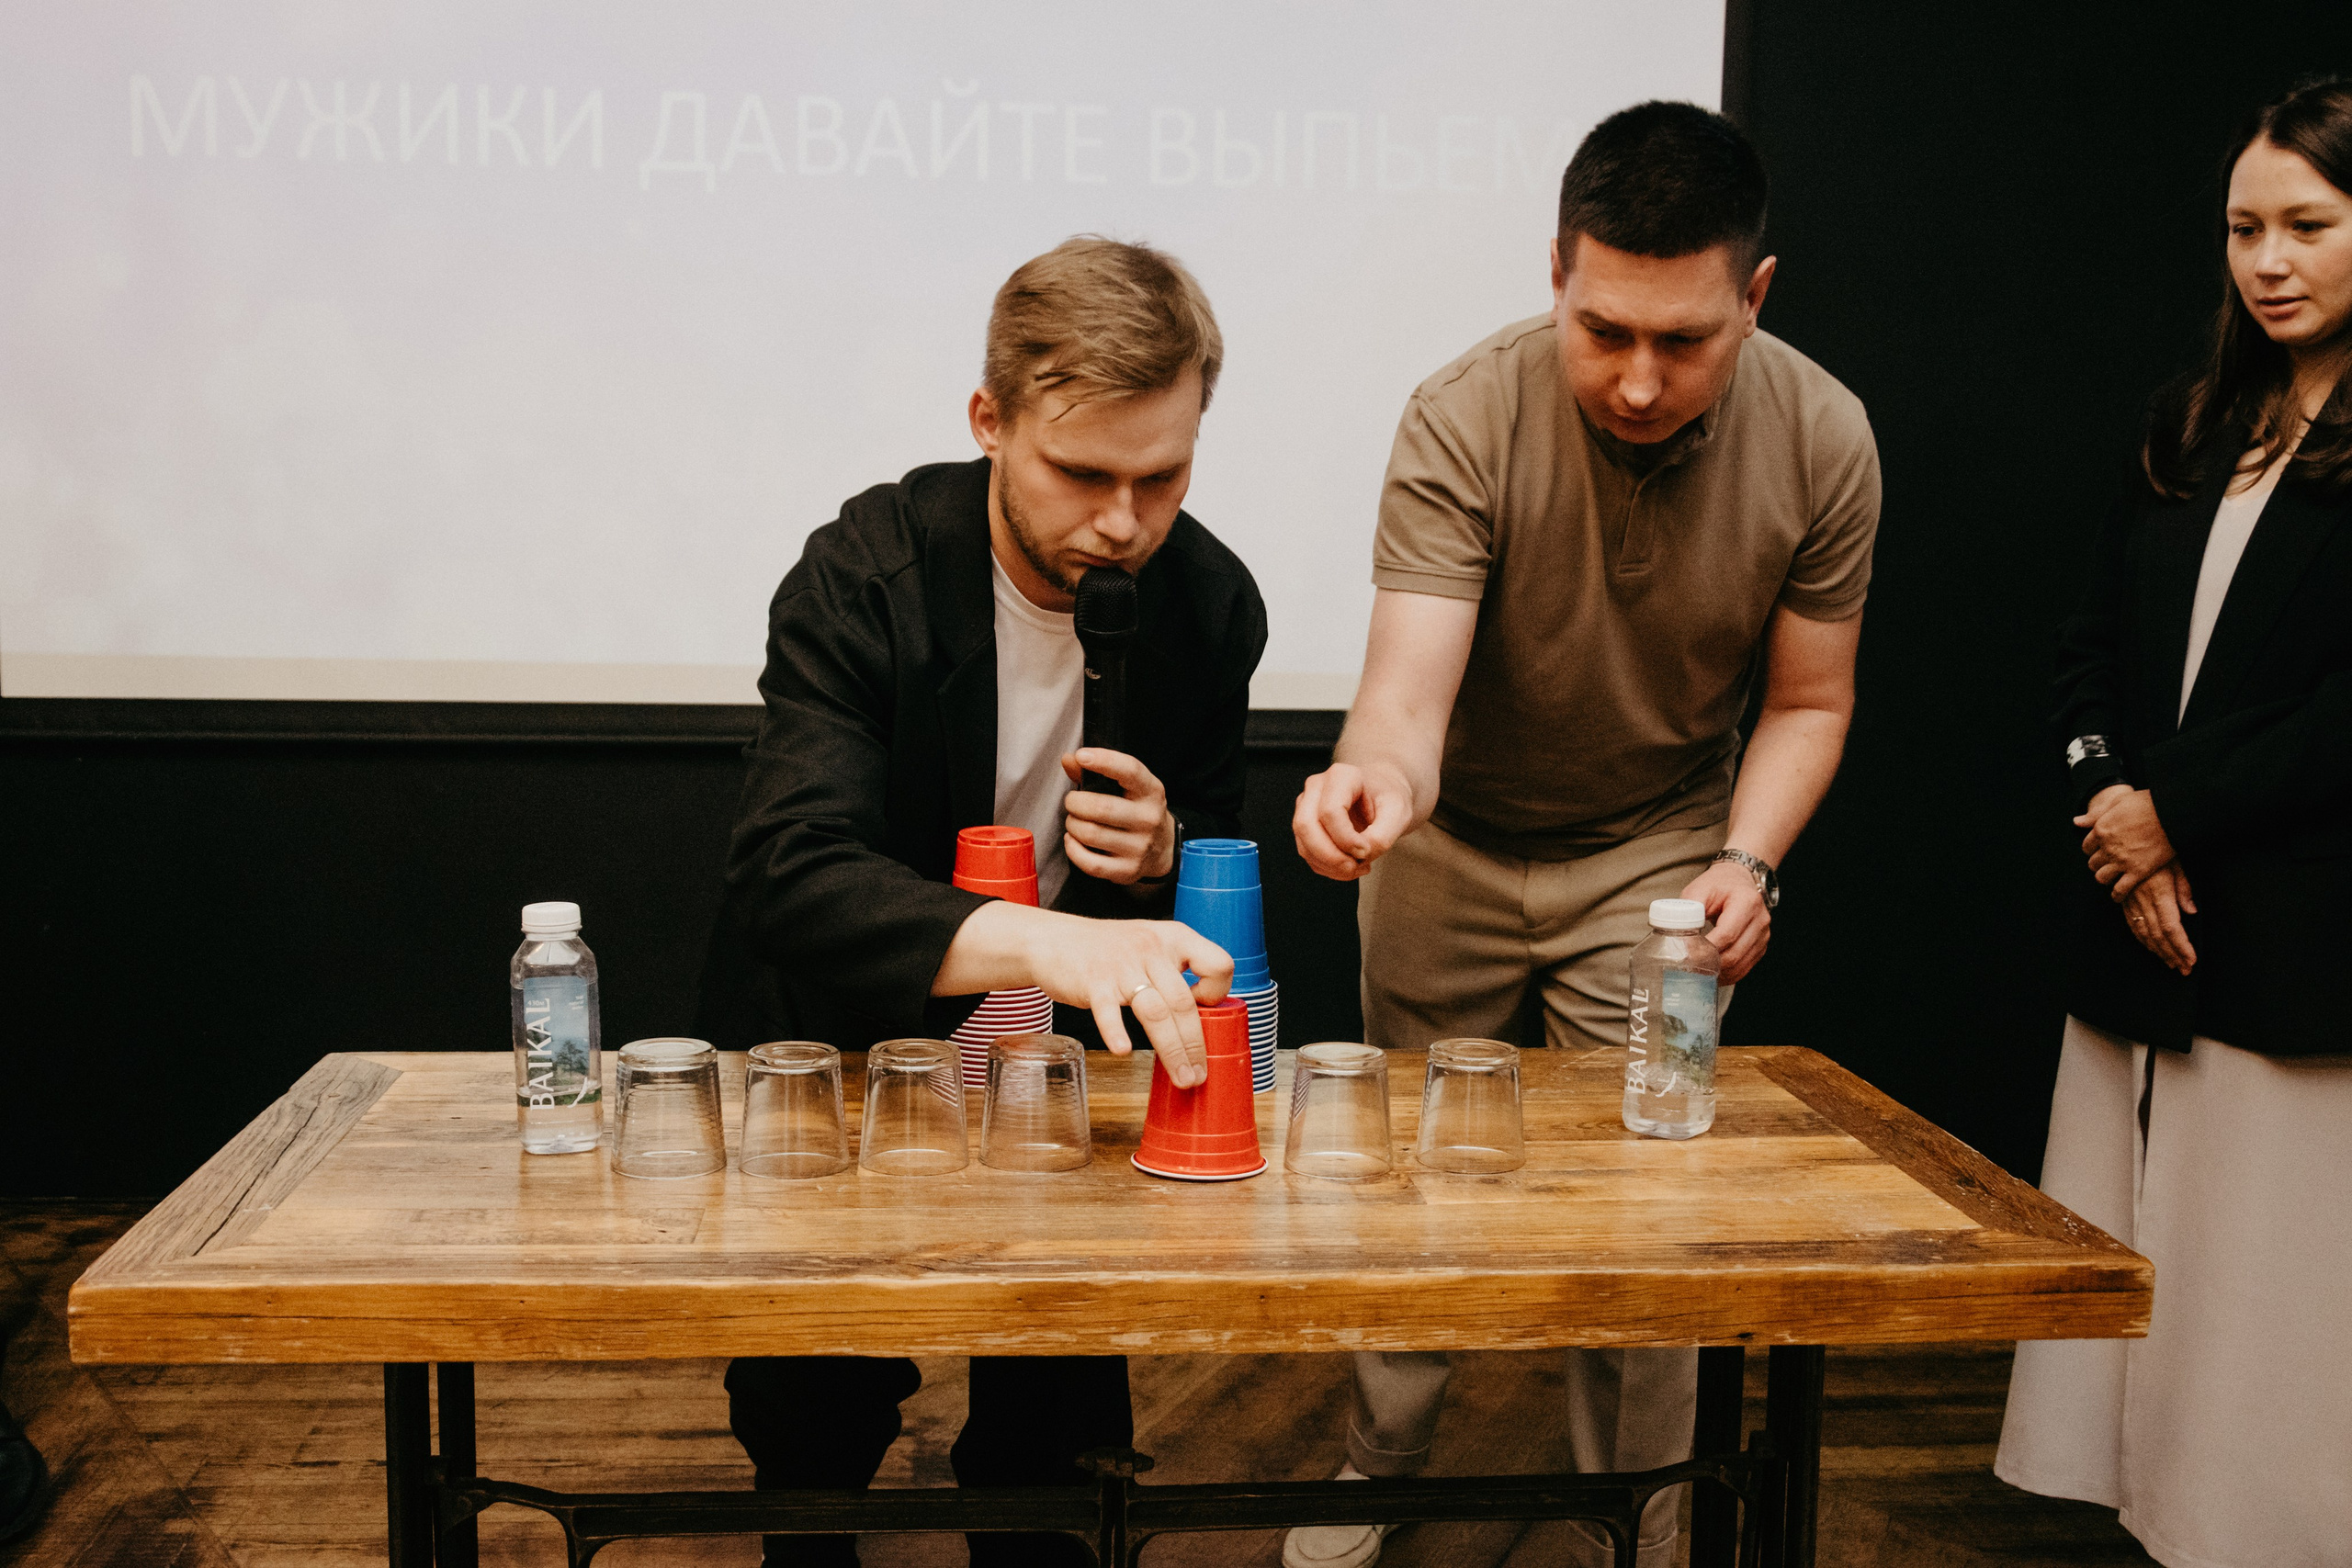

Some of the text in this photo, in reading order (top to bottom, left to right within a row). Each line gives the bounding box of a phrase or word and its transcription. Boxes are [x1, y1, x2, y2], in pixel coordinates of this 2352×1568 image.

[128, 73, 606, 171] МУЖИКИ
[638, 77, 1112, 194] ДАВАЙТЕ
[526, 998, 555, 1111] BAIKAL
[1627, 989, 1649, 1095] BAIKAL
